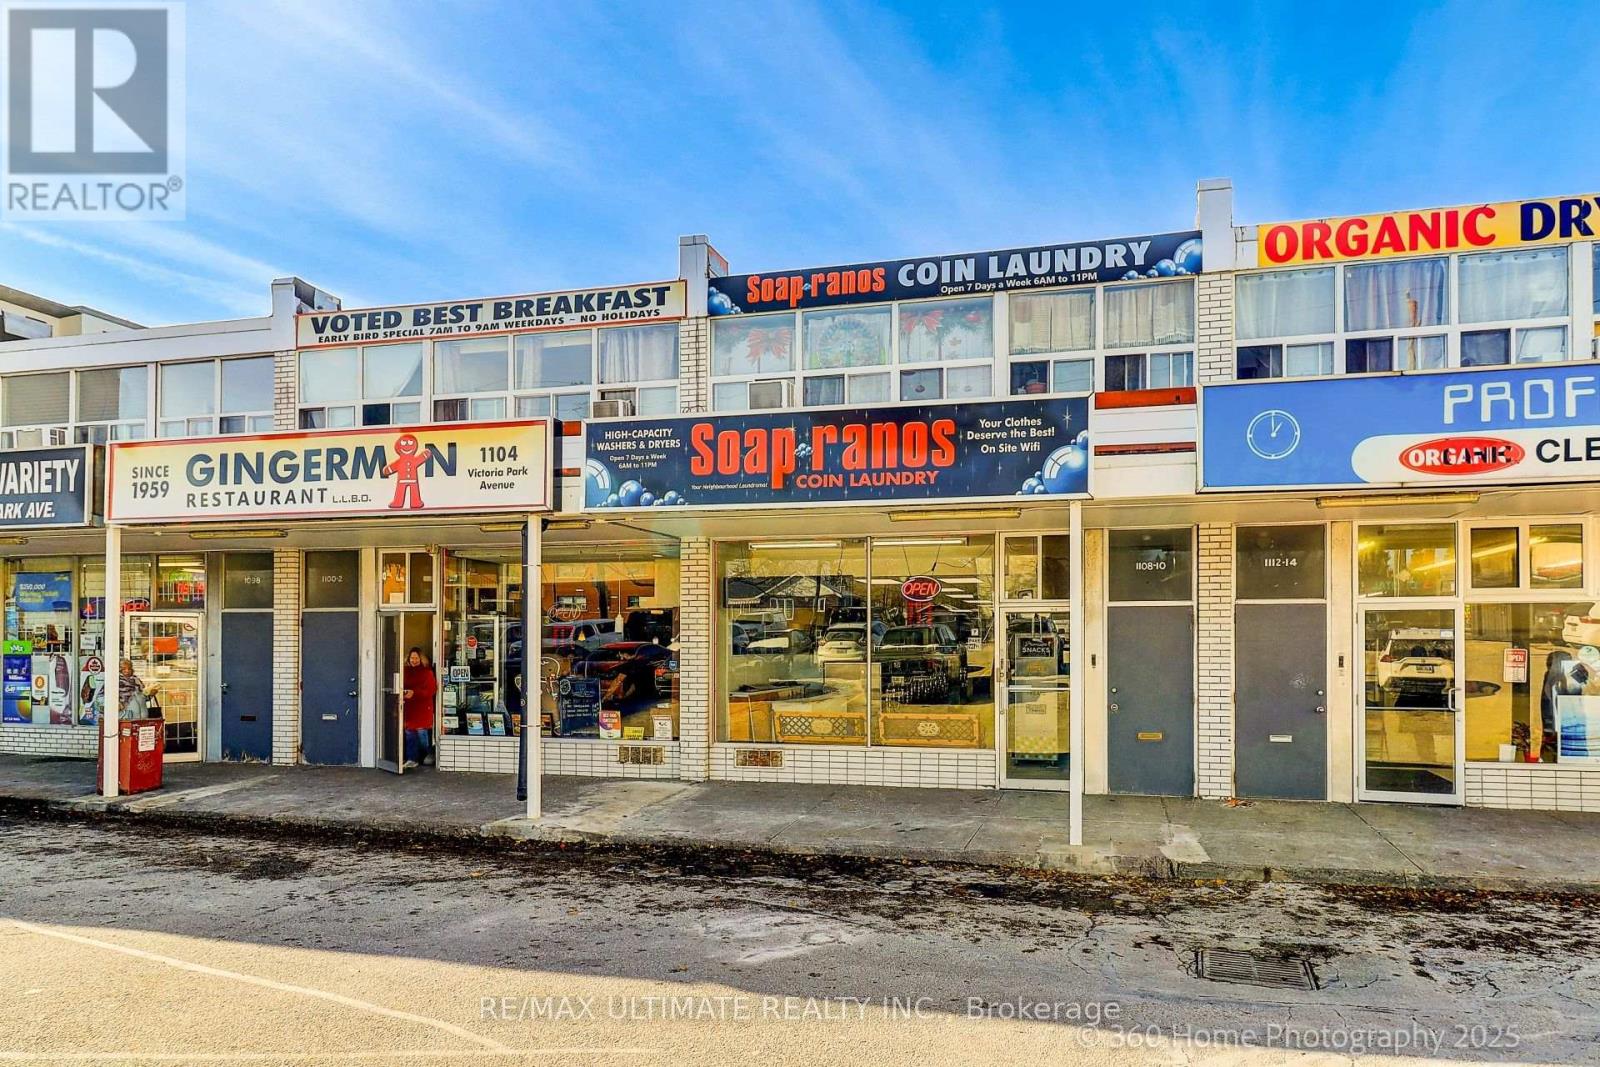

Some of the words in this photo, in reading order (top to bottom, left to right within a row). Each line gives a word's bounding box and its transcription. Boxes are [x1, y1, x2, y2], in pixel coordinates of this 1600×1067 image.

[1264, 206, 1496, 264] ORGANIC
[1520, 197, 1600, 242] DR
[898, 258, 975, 287] COIN
[988, 240, 1151, 278] LAUNDRY
[941, 285, 964, 295] Open
[966, 283, 972, 291] 7
[975, 282, 996, 292] Days
[1006, 278, 1031, 288] Week
[1034, 276, 1055, 285] 6AM
[1071, 272, 1097, 282] 11PM
[311, 310, 402, 334] VOTED
[413, 303, 483, 327] BEST
[493, 286, 670, 320] BREAKFAST
[319, 334, 349, 343] EARLY
[353, 331, 379, 341] BIRD
[383, 328, 425, 339] SPECIAL
[429, 326, 453, 335] 7AM
[457, 325, 471, 333] TO
[475, 323, 499, 332] 9AM
[504, 317, 564, 328] WEEKDAYS
[580, 314, 597, 323] NO
[601, 309, 660, 321] HOLIDAYS
[1443, 376, 1596, 424] PROF
[979, 418, 1002, 428] Your
[1004, 417, 1042, 427] Clothes
[605, 428, 673, 440] HIGH-CAPACITY
[967, 430, 1007, 440] Deserve
[1010, 429, 1026, 438] the
[1030, 426, 1055, 437] Best!
[597, 441, 637, 450] WASHERS
[639, 440, 646, 449] &
[648, 439, 681, 448] DRYERS
[980, 444, 996, 454] On
[998, 443, 1017, 452] Site
[1020, 442, 1040, 452] Wifi
[1536, 437, 1600, 463] CLE
[480, 446, 518, 462] 1104
[631, 454, 644, 462] Days
[132, 465, 170, 479] SINCE
[186, 442, 457, 487] GINGERMN
[467, 468, 505, 478] Victoria
[506, 467, 528, 477] Park
[796, 473, 843, 489] COIN
[850, 470, 939, 487] LAUNDRY
[132, 481, 170, 499] 1959
[480, 481, 515, 490] Avenue
[186, 488, 328, 508] RESTAURANT
[0, 503, 24, 519] RK
[25, 501, 55, 518] AVE.
[1136, 562, 1166, 570] 1108-10
[1264, 558, 1297, 567] 1112-14
[904, 582, 937, 595] OPEN
[452, 668, 469, 677] OPEN
